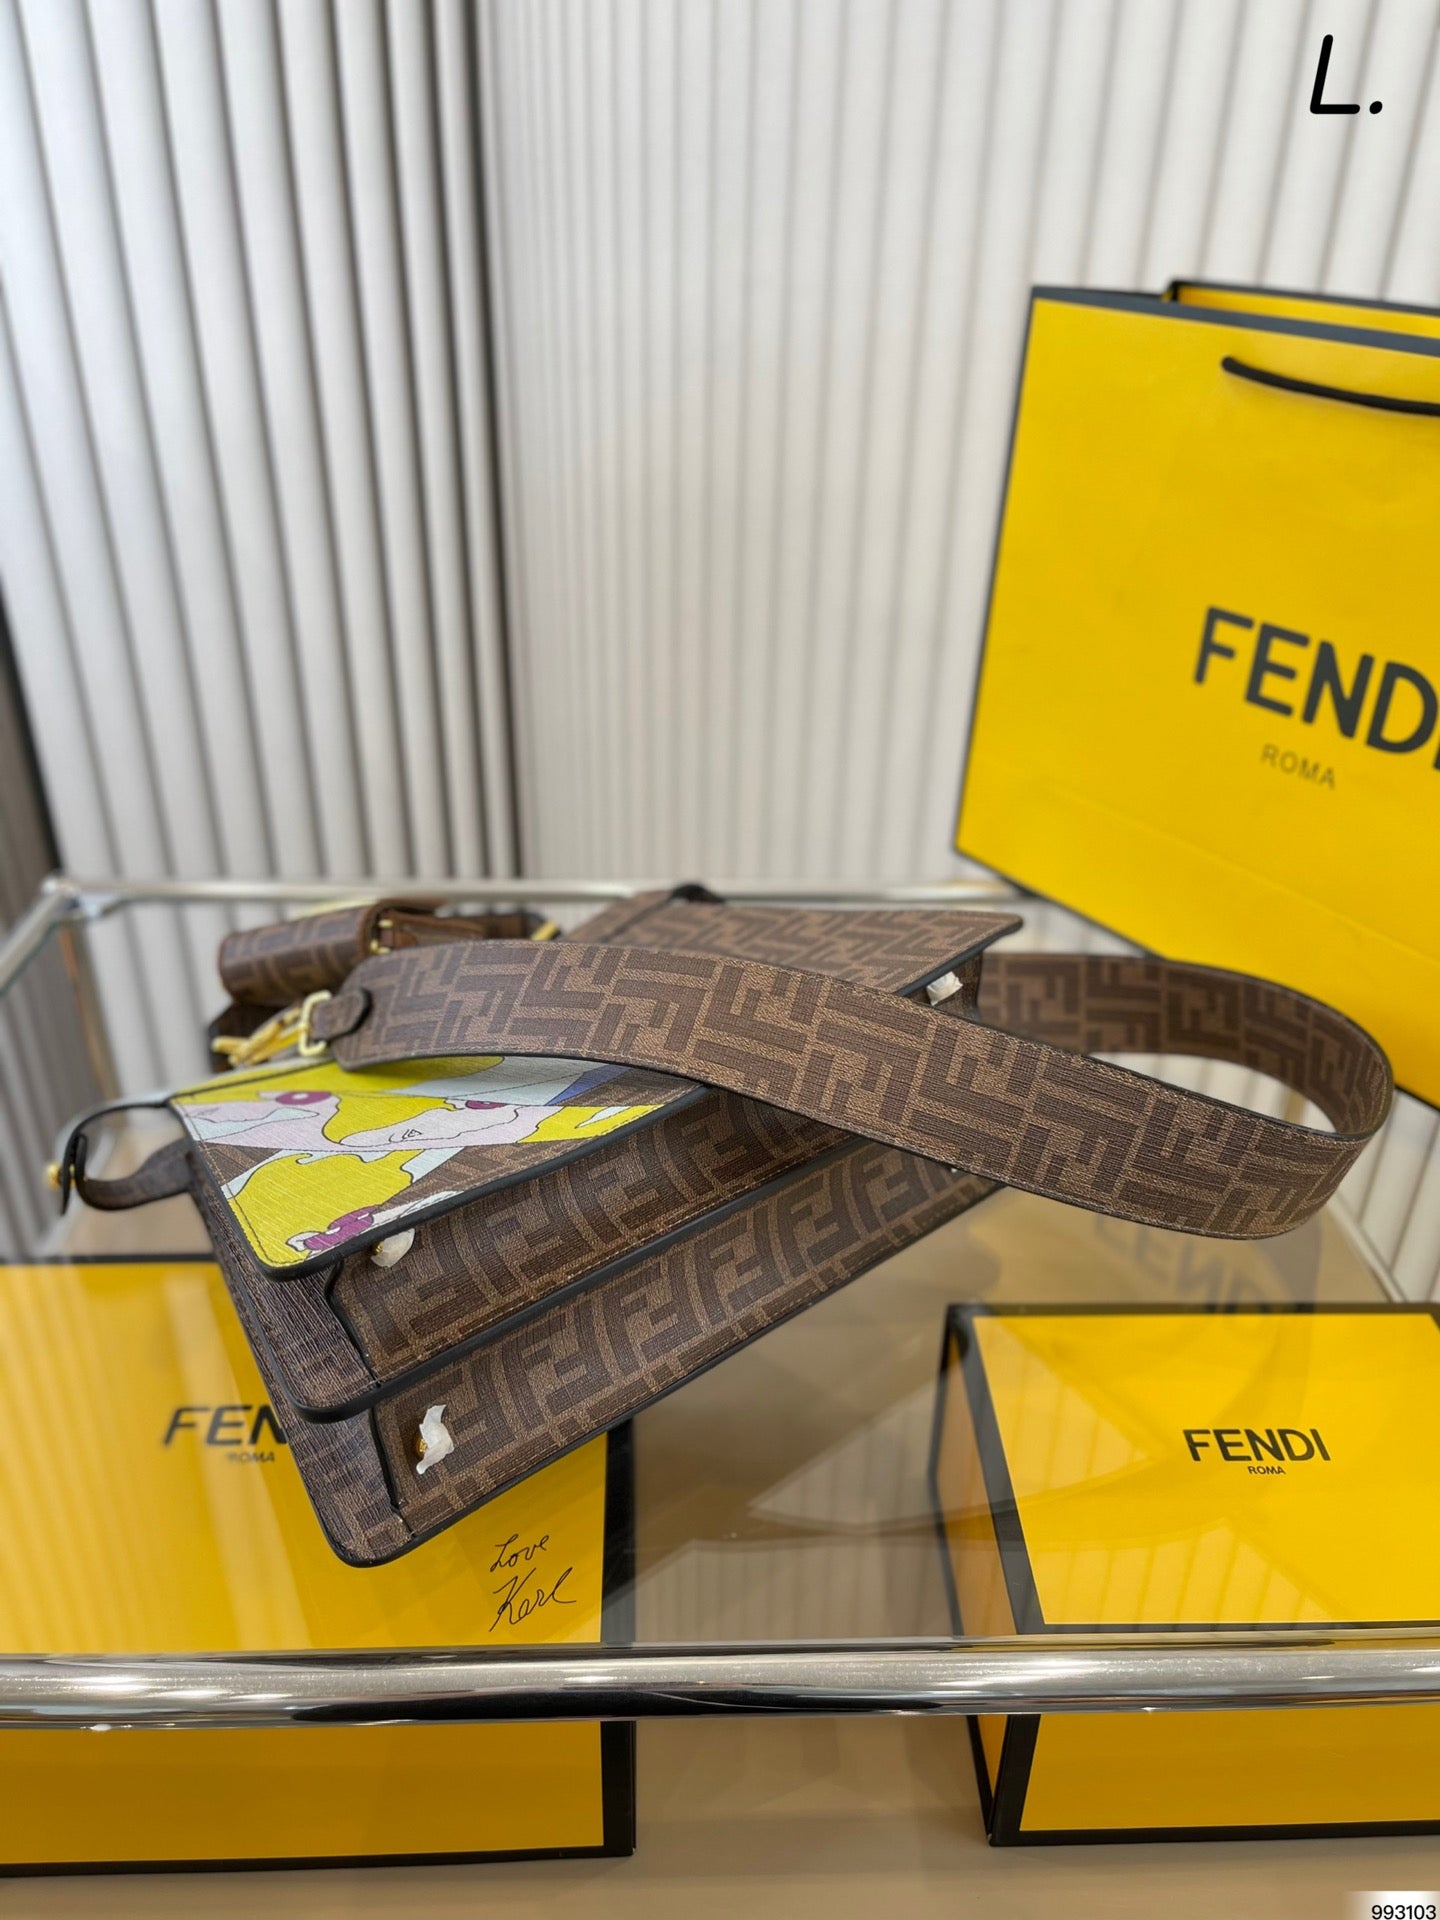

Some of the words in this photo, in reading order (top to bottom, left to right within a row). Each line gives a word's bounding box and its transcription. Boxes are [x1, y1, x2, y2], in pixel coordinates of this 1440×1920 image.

[1194, 605, 1440, 772] FEND
[1260, 743, 1336, 791] ROMA
[1183, 1428, 1331, 1462] FENDI
[1247, 1465, 1286, 1475] ROMA
[489, 1533, 550, 1573] Love
[488, 1567, 577, 1632] Karl
